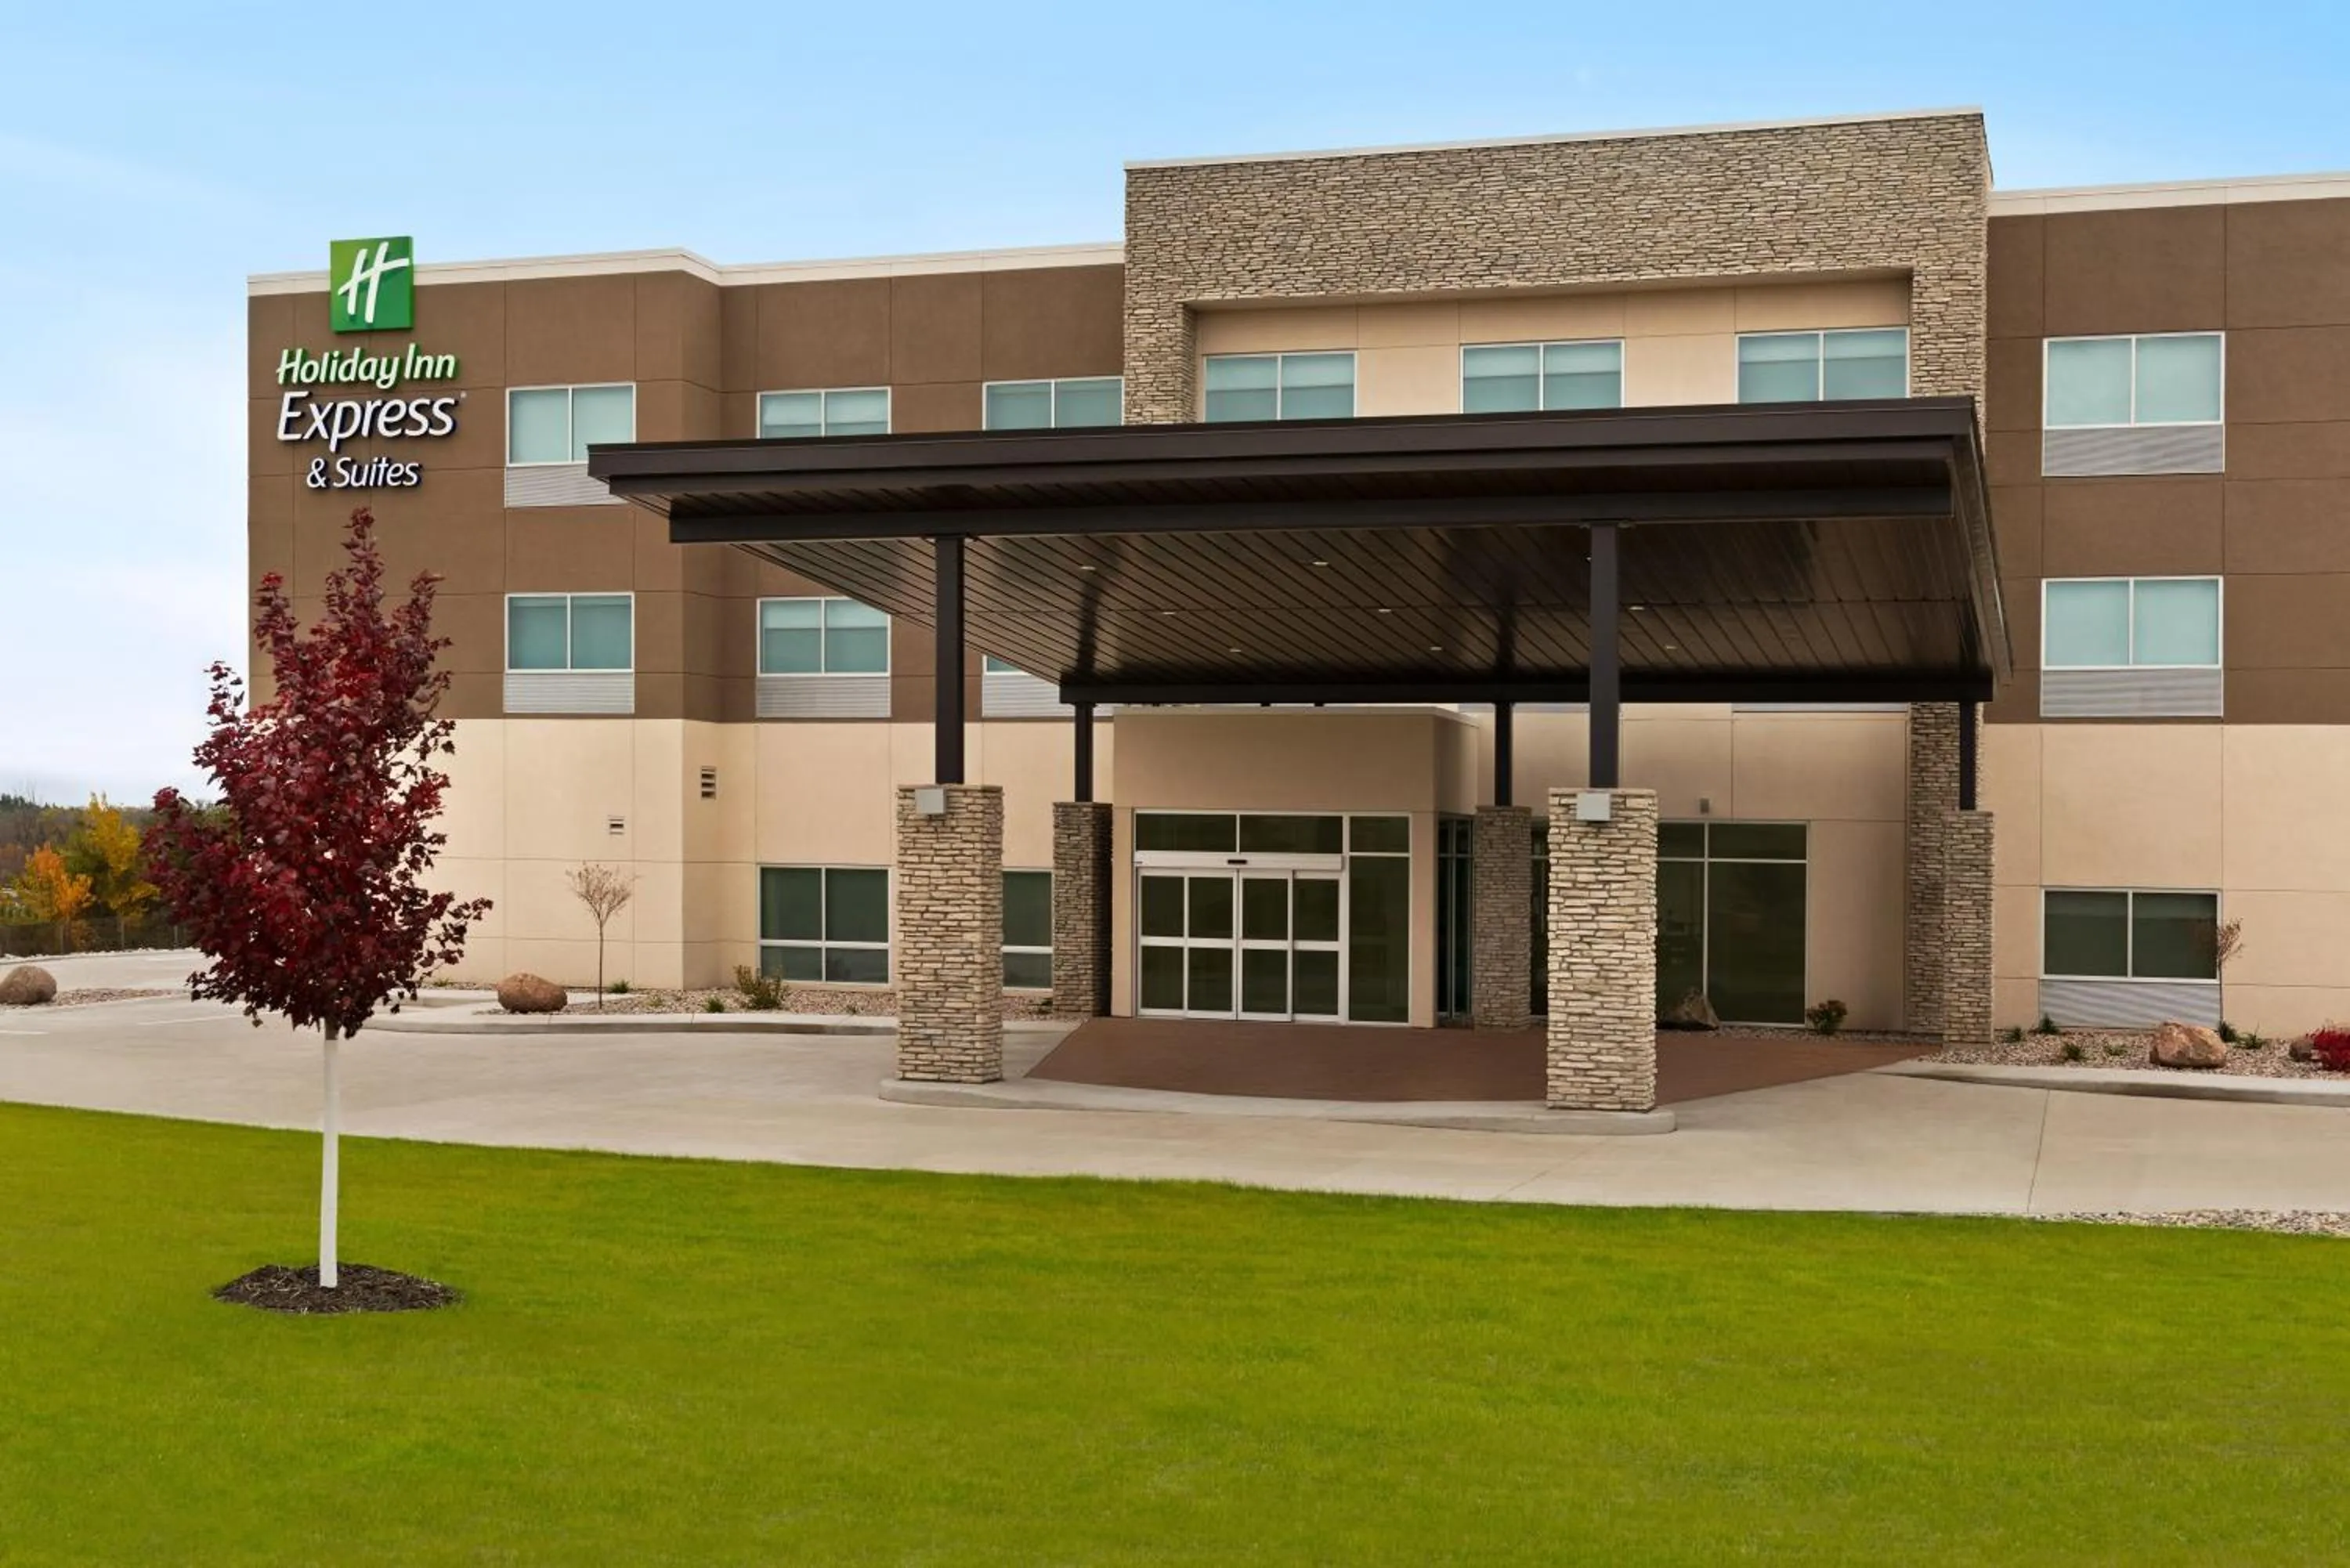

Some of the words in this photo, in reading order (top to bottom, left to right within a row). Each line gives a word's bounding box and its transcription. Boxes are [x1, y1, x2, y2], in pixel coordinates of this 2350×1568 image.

[277, 346, 400, 390] Holiday
[403, 342, 456, 381] Inn
[277, 390, 457, 453] Express
[306, 457, 326, 489] &
[333, 456, 420, 488] Suites
